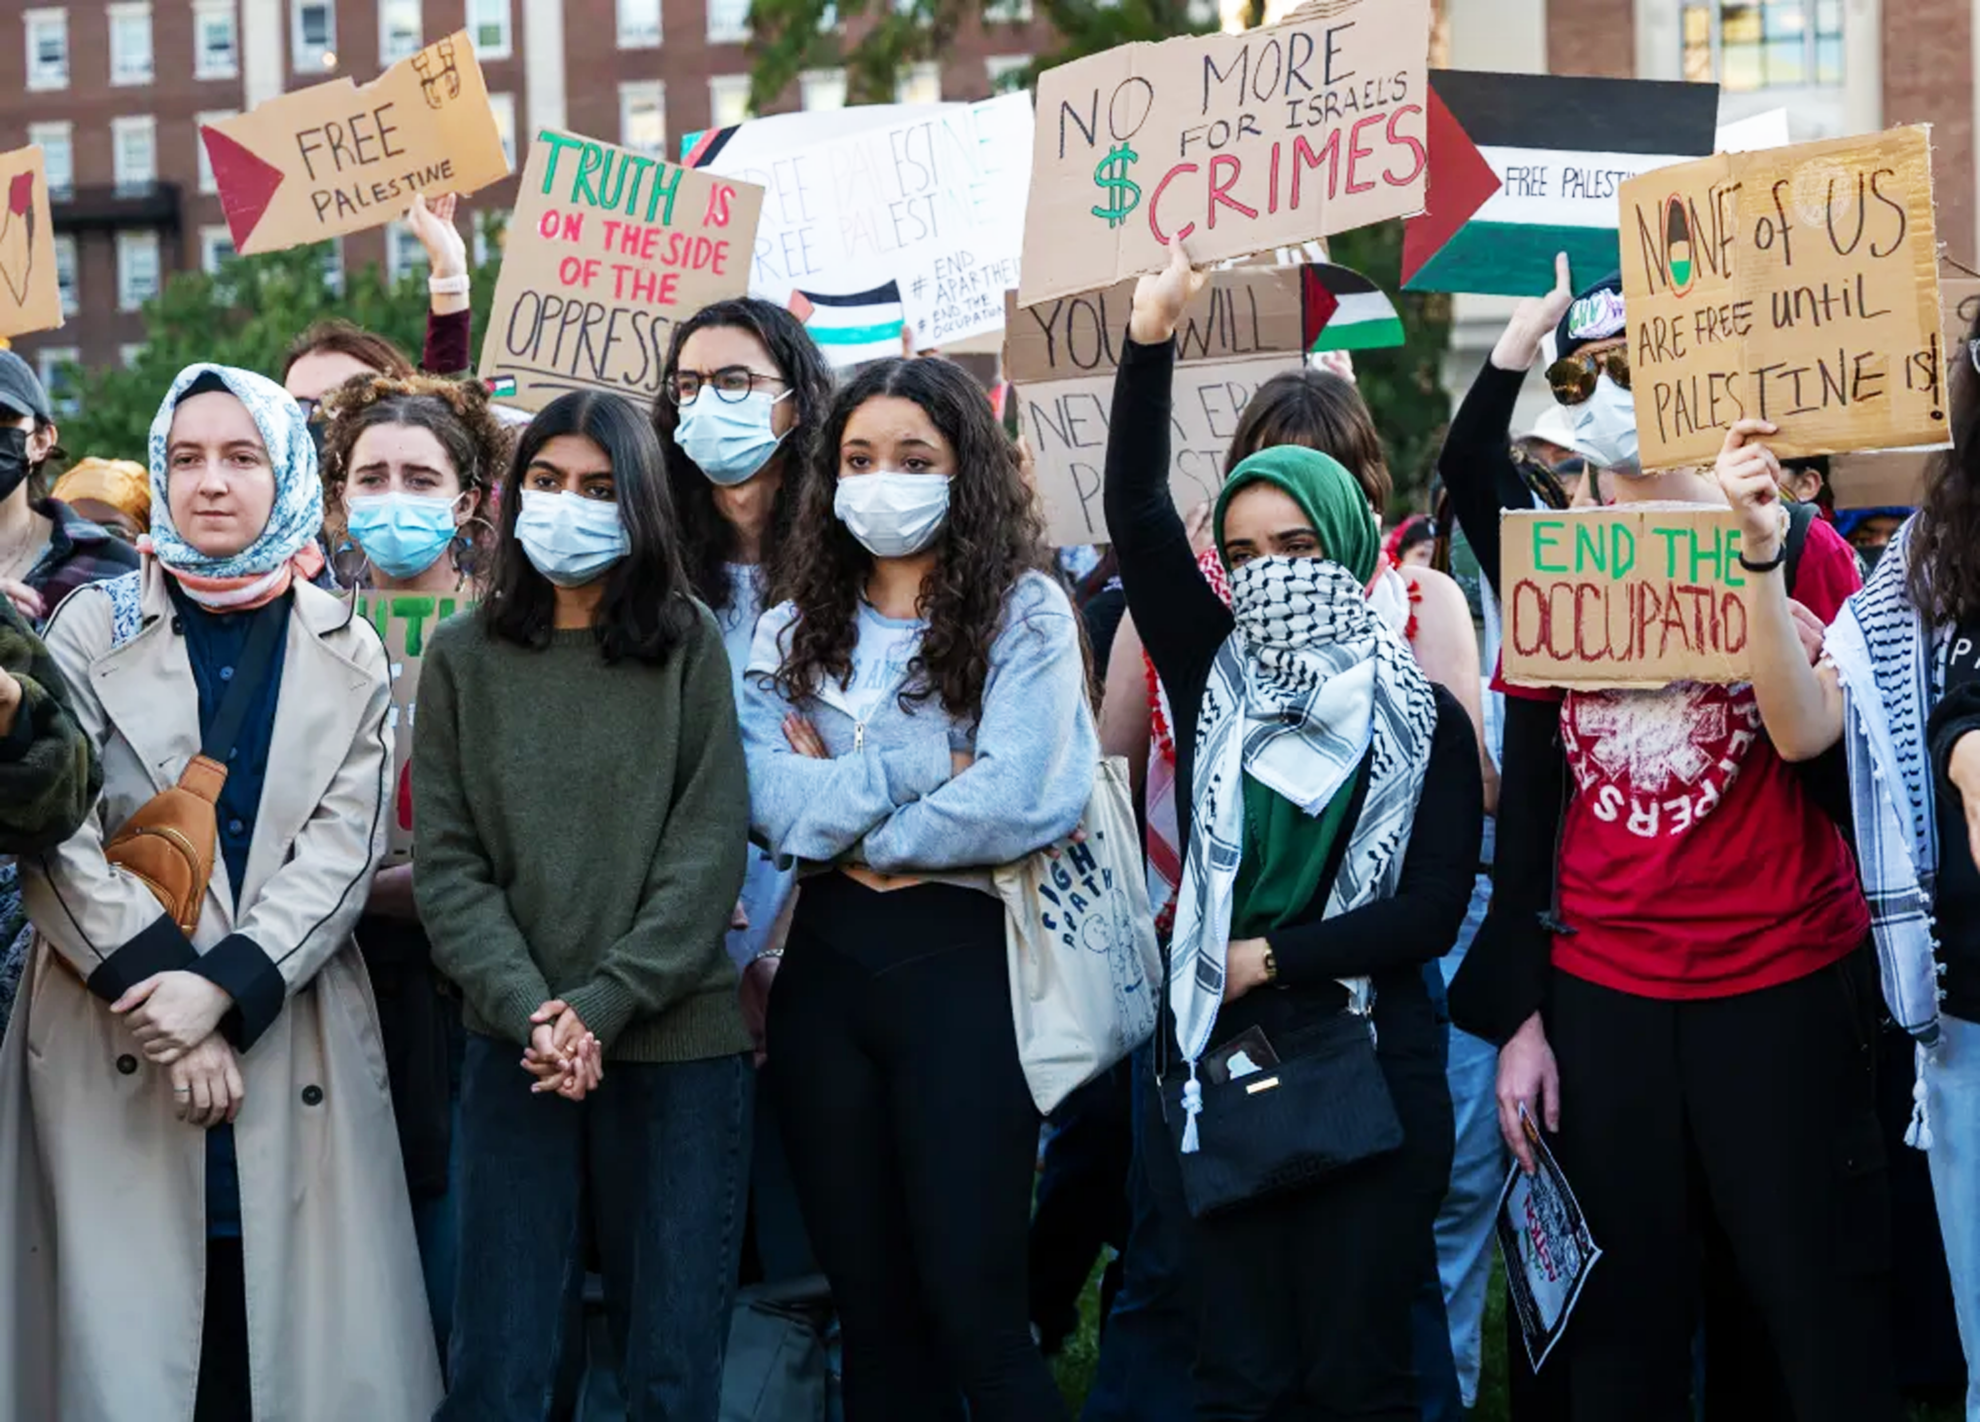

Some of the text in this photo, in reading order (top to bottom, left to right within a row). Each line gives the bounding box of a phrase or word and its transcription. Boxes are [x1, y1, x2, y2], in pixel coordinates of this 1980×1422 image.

[1059, 21, 1356, 158] NO MORE
[1181, 71, 1408, 157] FOR ISRAEL'S
[296, 102, 405, 181] FREE
[538, 130, 736, 227] TRUTH IS
[1149, 104, 1428, 245] CRIMES
[311, 159, 454, 223] PALESTINE
[731, 155, 819, 226] REE
[1091, 142, 1142, 228] $
[1505, 166, 1636, 198] FREE PALEST
[539, 209, 730, 275] ON THE SIDE
[755, 227, 823, 283] REE
[1636, 182, 1742, 299] NONE
[1826, 168, 1906, 258] US
[559, 256, 680, 305] OF THE
[936, 257, 1021, 305] APARTHEI
[507, 290, 686, 392] OPPRESS
[1176, 285, 1279, 360] WILL
[1639, 315, 1687, 368] ARE
[1695, 301, 1753, 345] FREE
[1653, 347, 1885, 444] PALESTINE
[1532, 521, 1746, 587] END THE
[1512, 578, 1748, 662] OCCUPATIO
